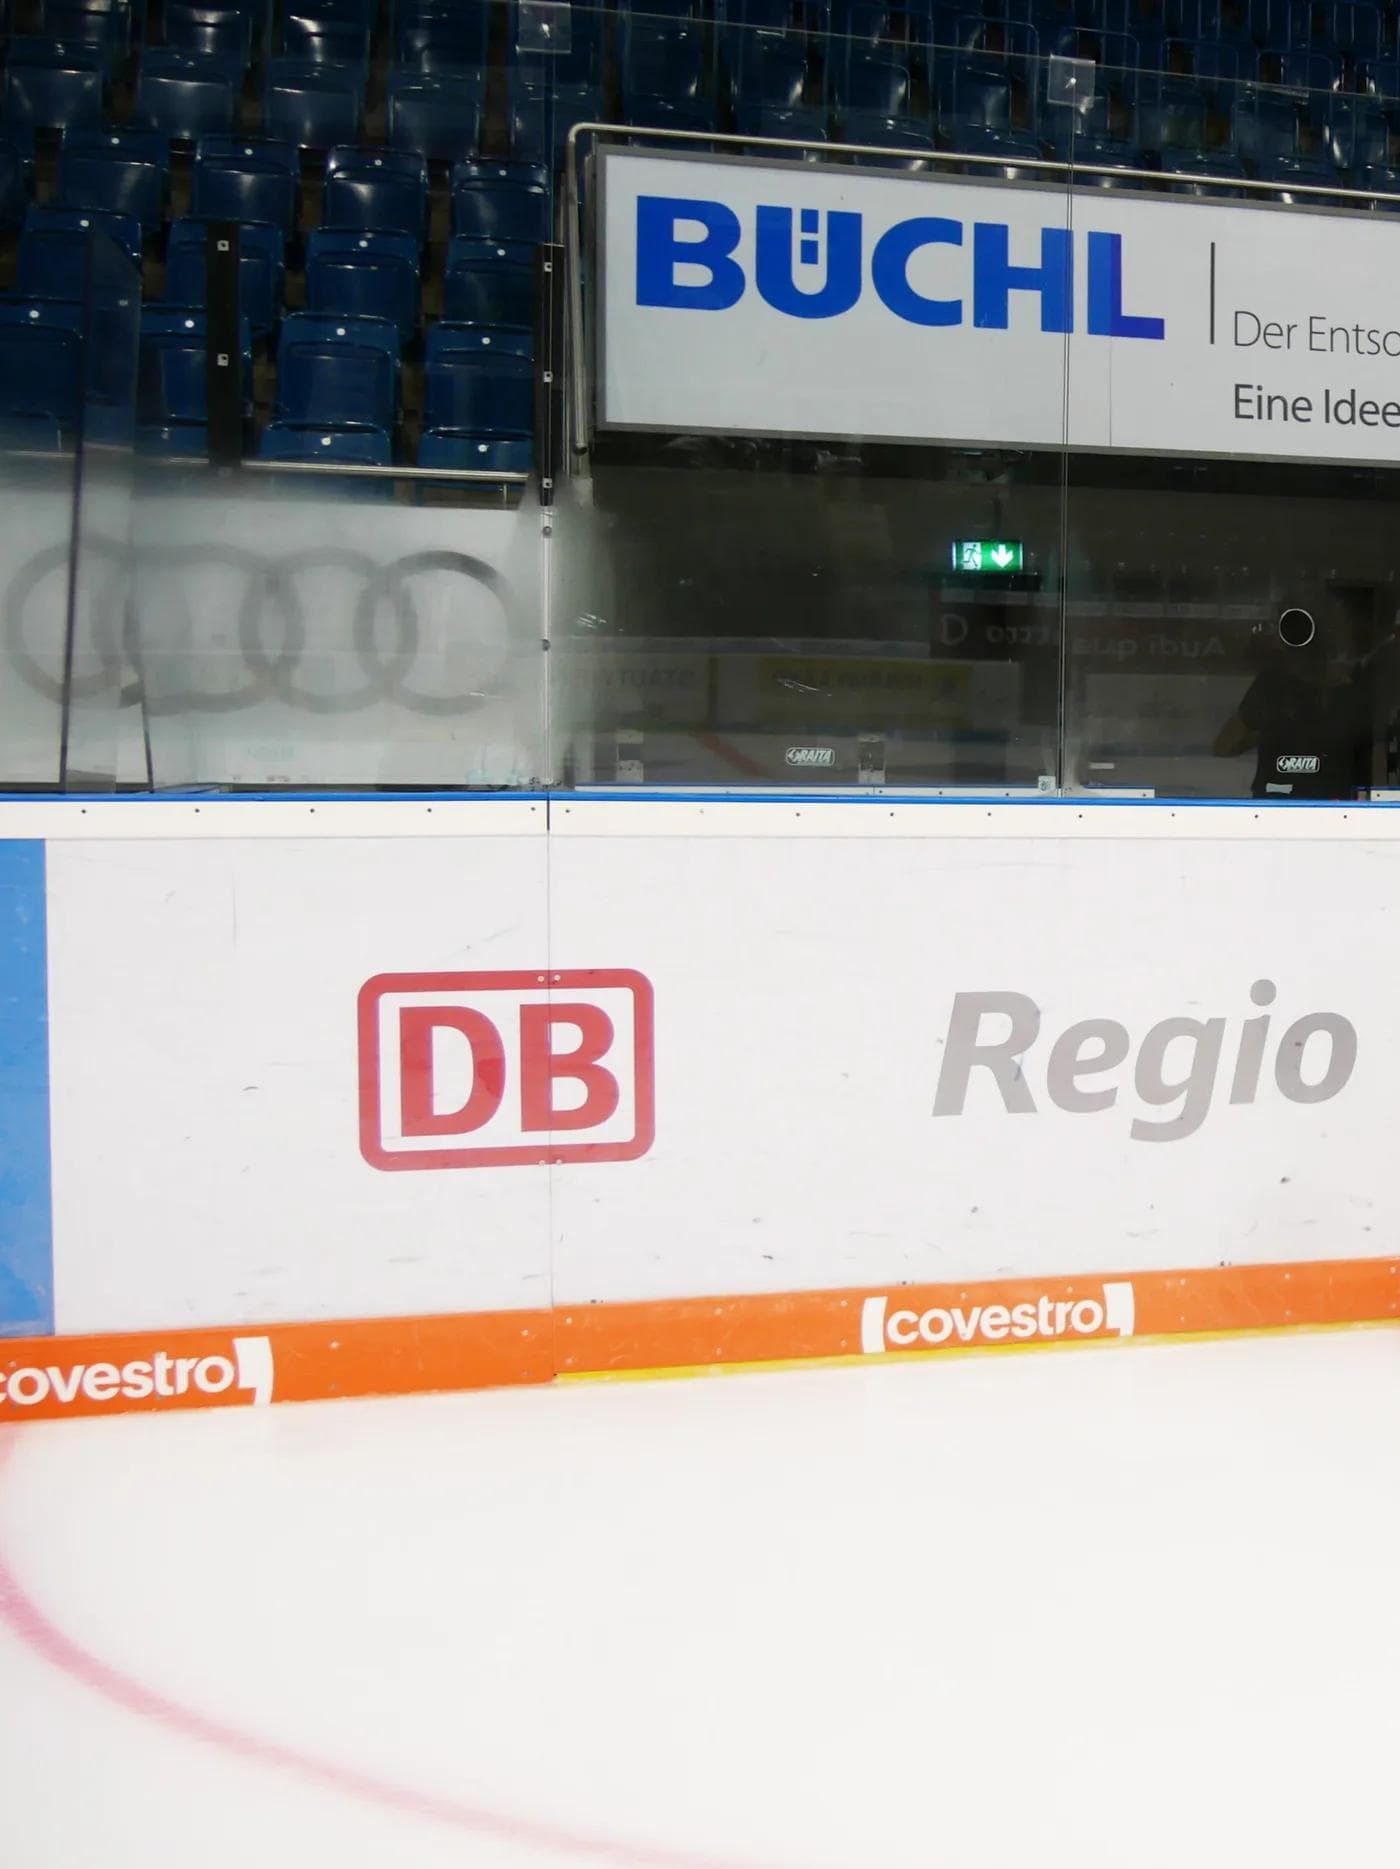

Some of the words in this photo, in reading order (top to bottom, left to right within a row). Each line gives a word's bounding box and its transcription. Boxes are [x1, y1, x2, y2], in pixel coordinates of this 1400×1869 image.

[636, 195, 1165, 340] BÜCHL
[1234, 311, 1298, 349] Der
[1234, 384, 1312, 422] Eine
[399, 1003, 620, 1137] DB
[931, 979, 1358, 1142] Regio
[887, 1296, 1103, 1344] covestro
